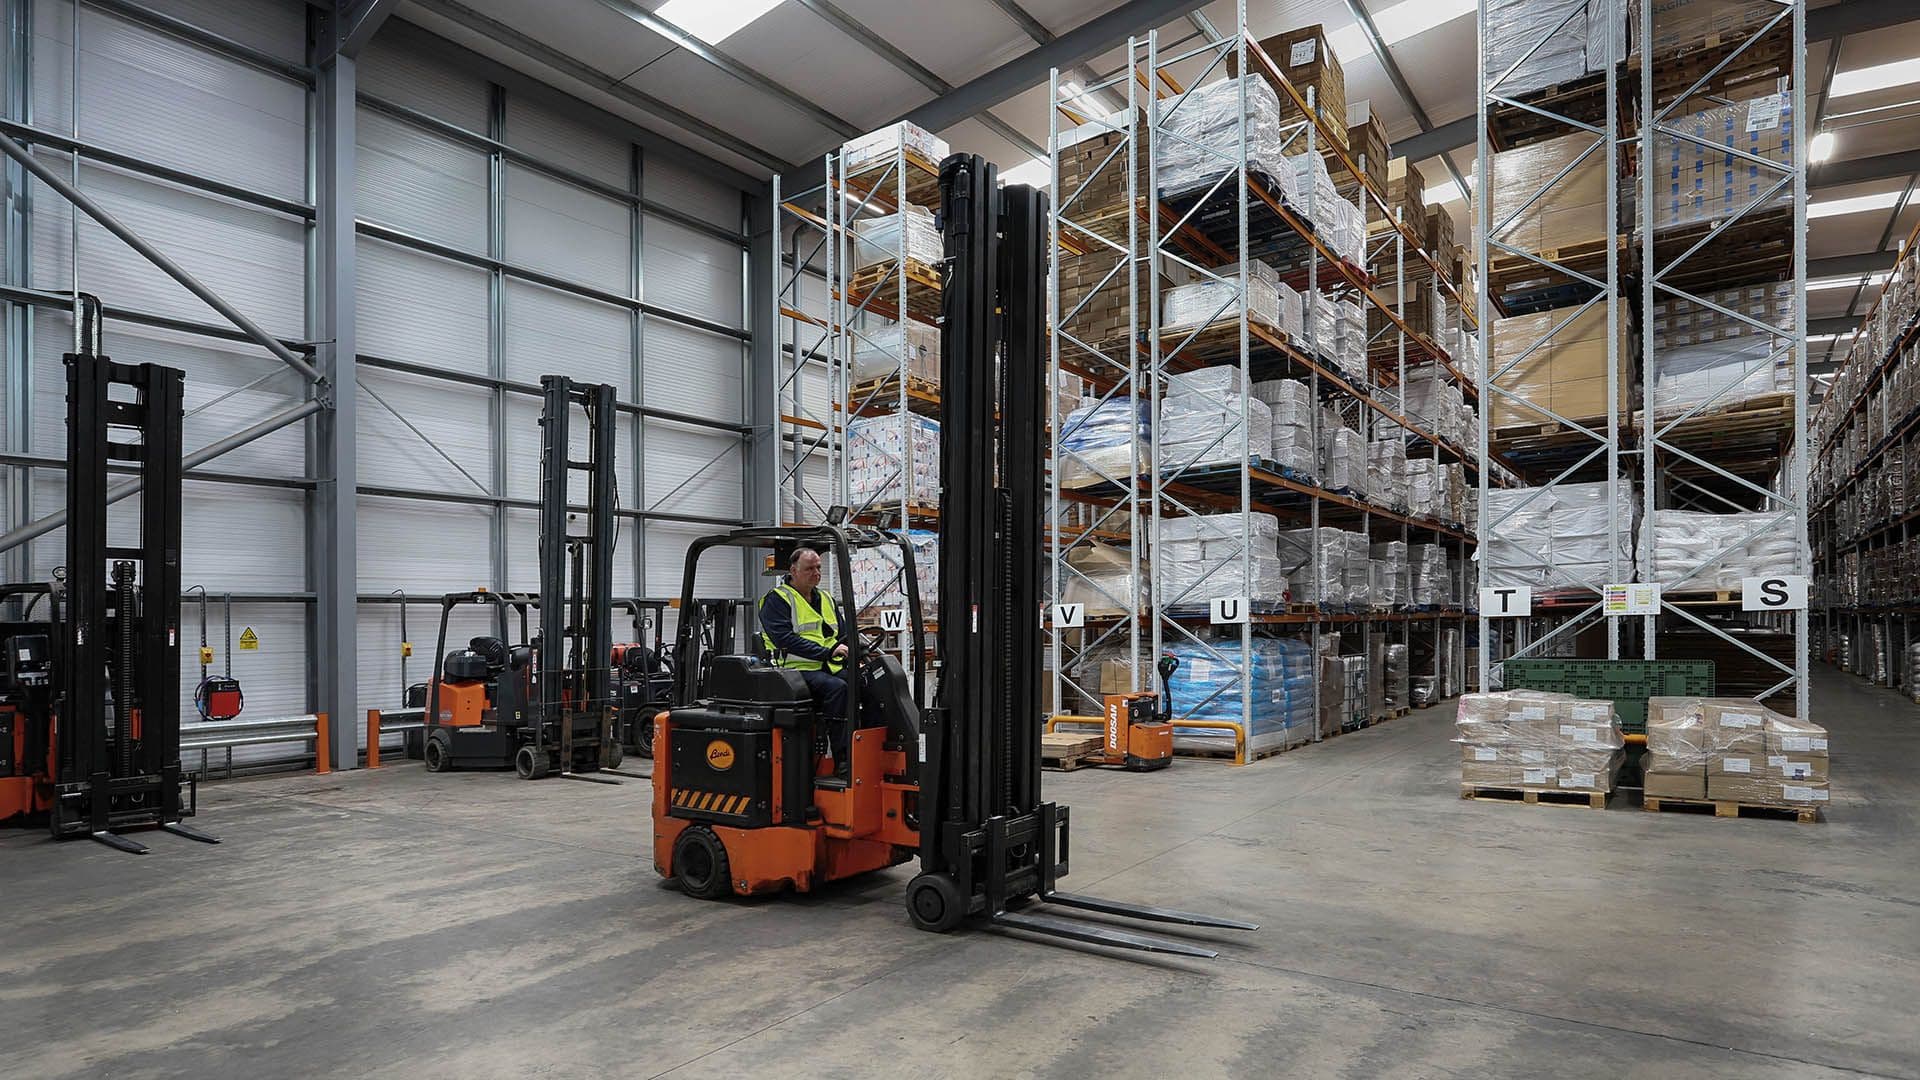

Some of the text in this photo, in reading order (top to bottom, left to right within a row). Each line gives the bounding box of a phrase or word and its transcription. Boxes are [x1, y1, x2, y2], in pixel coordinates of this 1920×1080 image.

[1494, 589, 1516, 613] T
[1760, 579, 1789, 606] S
[885, 611, 902, 628] W
[1060, 606, 1076, 624] V
[1221, 599, 1238, 620] U
[1109, 704, 1117, 749] DOOSAN
